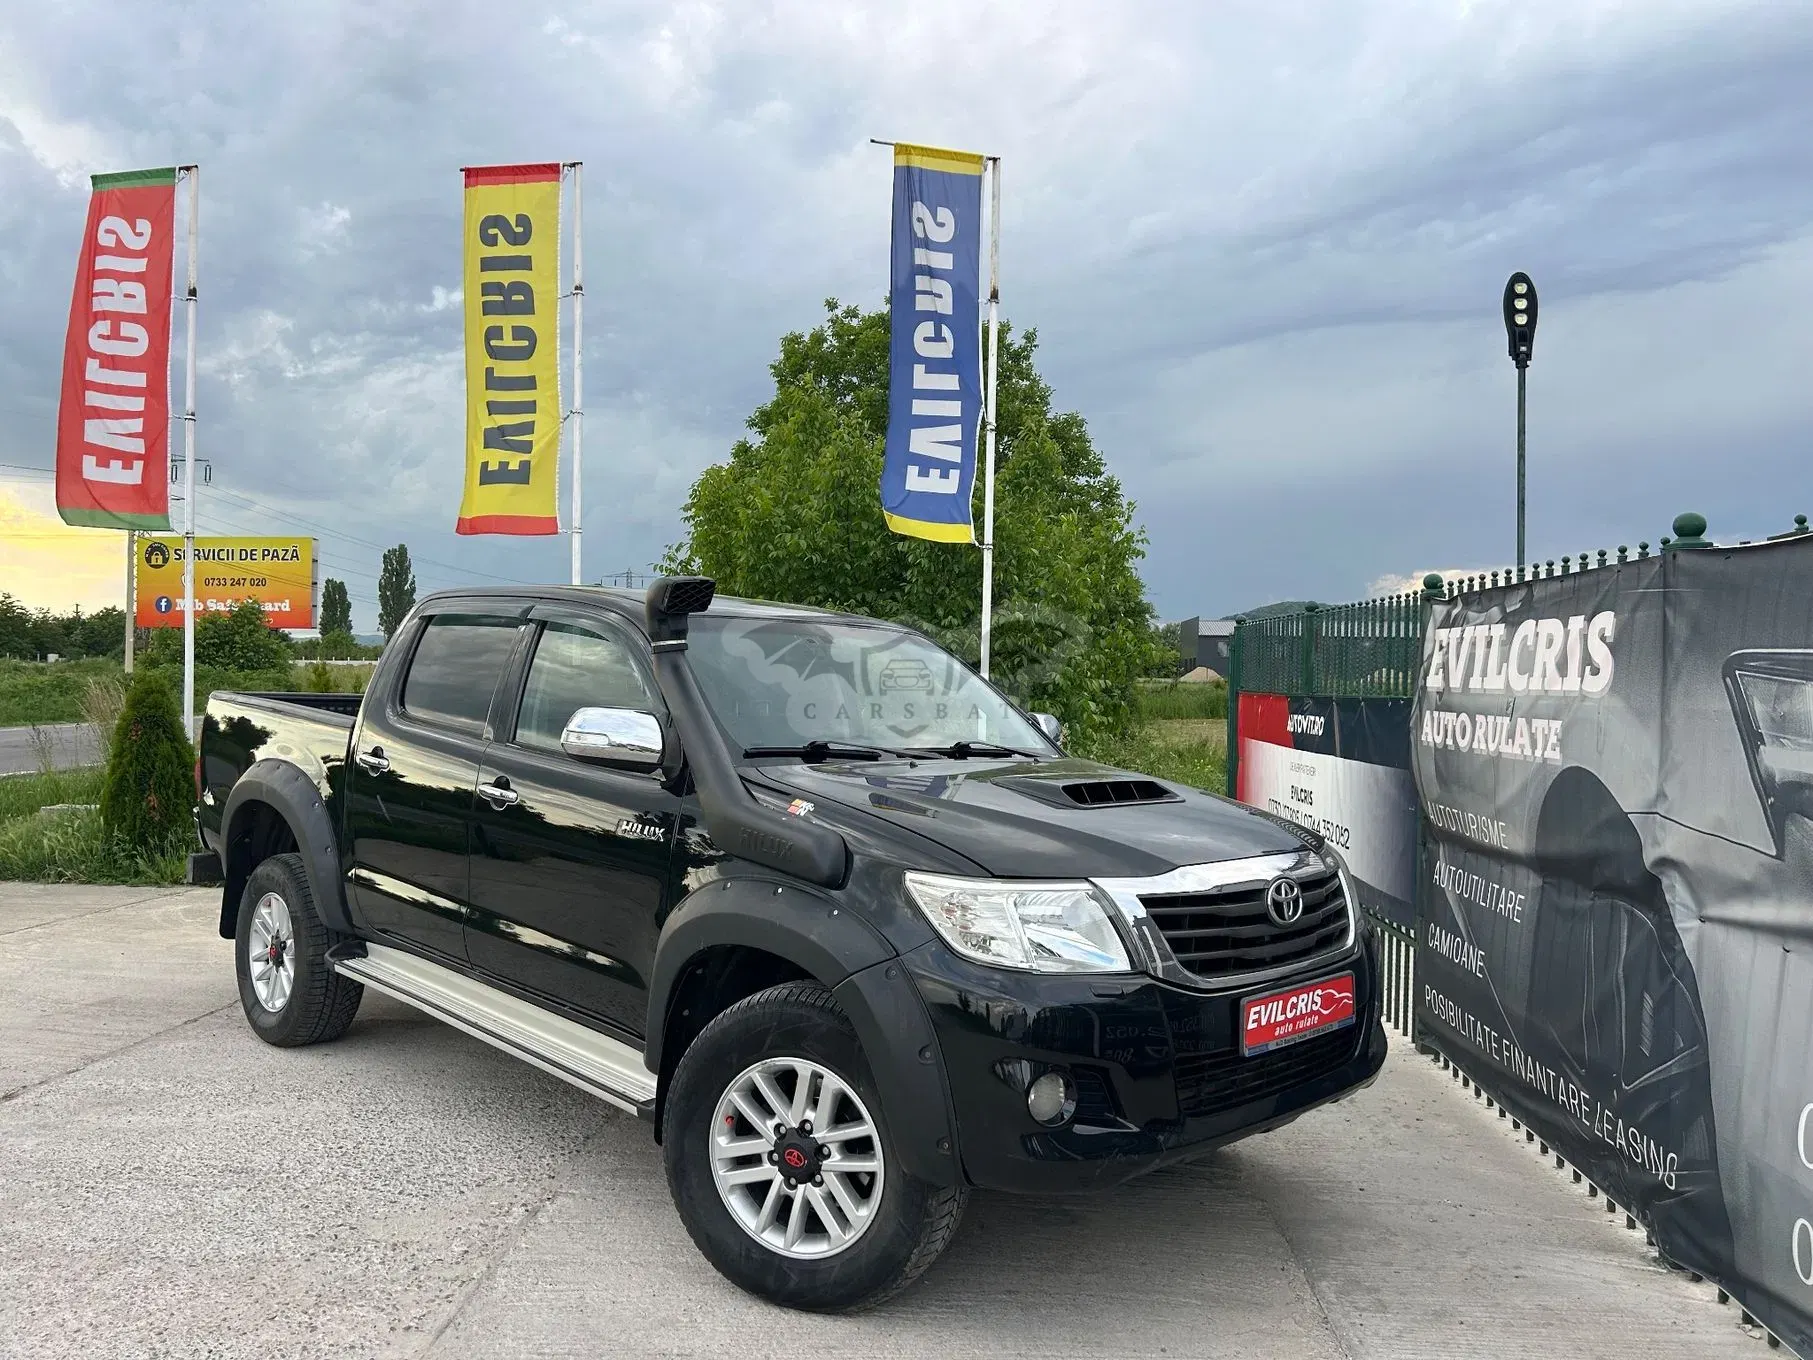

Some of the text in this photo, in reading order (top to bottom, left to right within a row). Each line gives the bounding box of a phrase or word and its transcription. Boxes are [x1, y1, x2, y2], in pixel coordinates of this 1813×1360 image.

[174, 548, 235, 561] SRVICII
[239, 548, 258, 561] DE
[204, 577, 267, 587] 0733 247 020
[1426, 611, 1615, 696] EVILCRIS
[1421, 710, 1563, 761] AUTO RULATE
[1290, 785, 1314, 806] EVILCRIS
[621, 819, 666, 842] HILUX
[1335, 824, 1350, 850] 052
[1427, 801, 1509, 849] AUTOTURISME
[1432, 860, 1525, 924] AUTOUTILITARE
[1428, 922, 1486, 978] CAMIOANE
[1247, 989, 1322, 1030] EVILCRIS
[1274, 1022, 1293, 1036] auto
[1295, 1014, 1319, 1030] rulate
[1425, 984, 1678, 1191] POSIBILITATE FINANTARE LEASING
